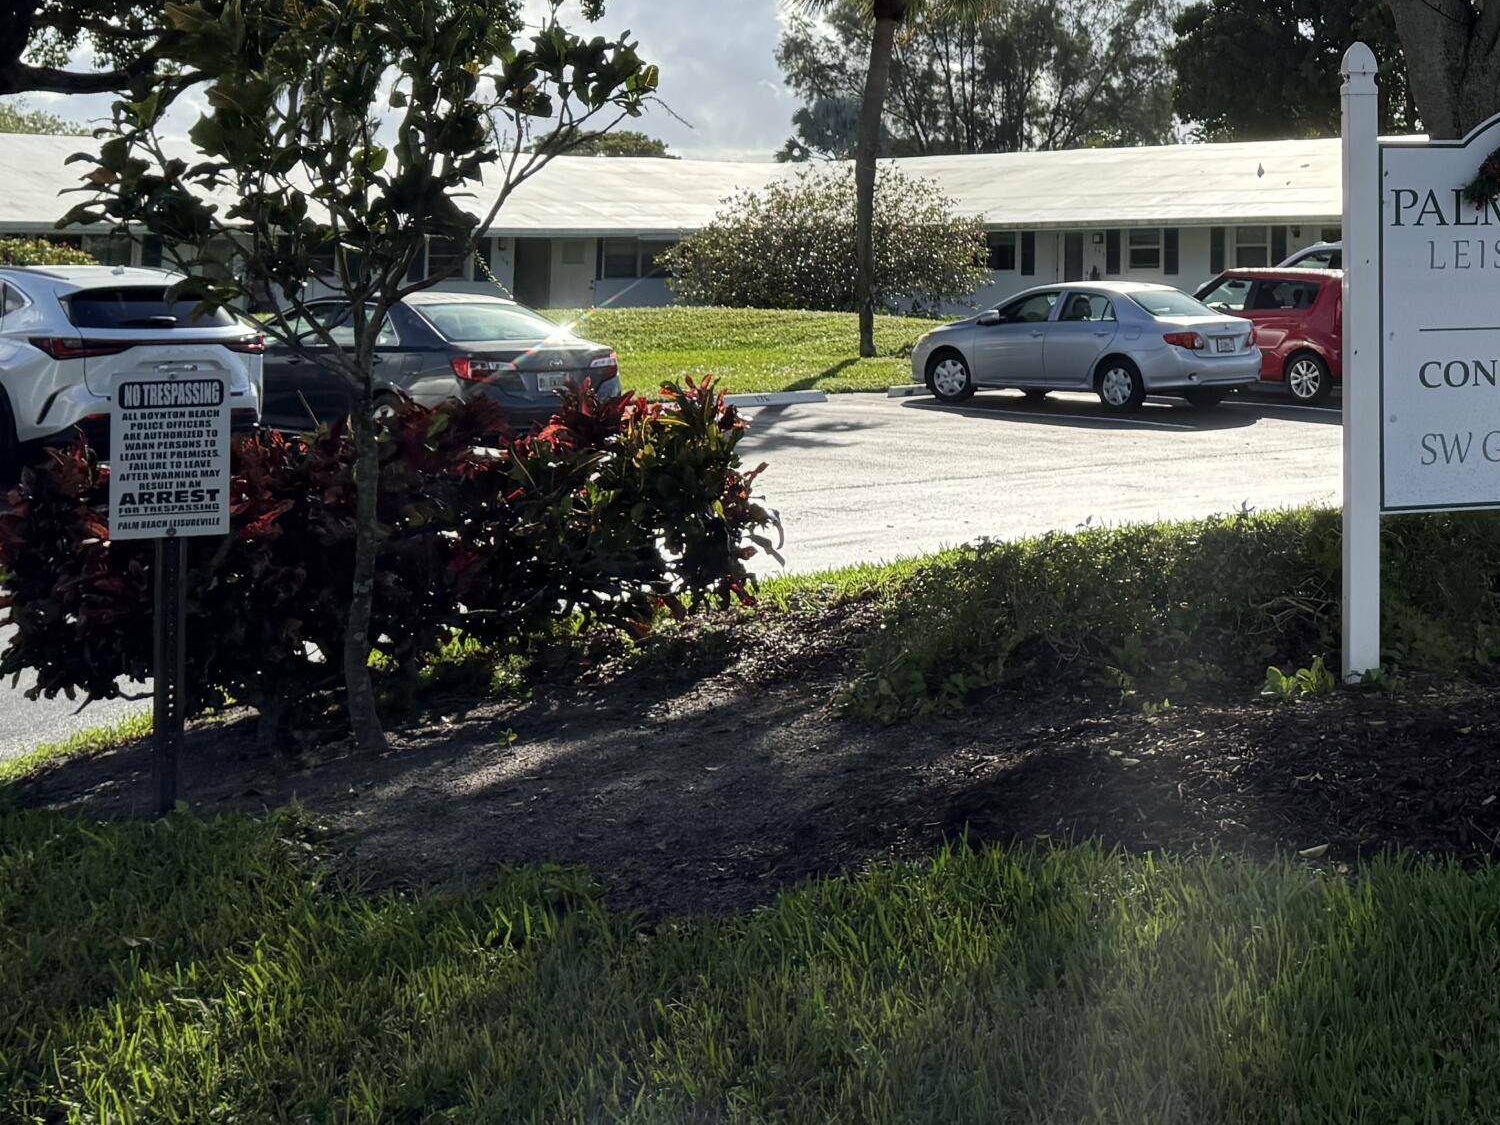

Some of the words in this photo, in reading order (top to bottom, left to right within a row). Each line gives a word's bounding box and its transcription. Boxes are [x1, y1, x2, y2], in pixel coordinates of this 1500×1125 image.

[124, 384, 140, 407] NO
[142, 381, 220, 406] TRESPASSING
[122, 412, 138, 421] ALL
[140, 411, 186, 420] BOYNTON
[188, 410, 220, 418] BEACH
[130, 421, 163, 430] POLICE
[166, 420, 212, 429] OFFICERS
[123, 432, 141, 441] ARE
[143, 430, 203, 440] AUTHORIZED
[206, 429, 218, 437] TO
[125, 442, 155, 451] WARN
[157, 440, 201, 449] PERSONS
[204, 439, 216, 448] TO
[1420, 431, 1473, 465] SW
[120, 452, 147, 461] LEAVE
[151, 451, 167, 460] THE
[129, 462, 167, 471] FAILURE
[170, 461, 181, 469] TO
[184, 459, 211, 468] LEAVE
[119, 472, 149, 481] AFTER
[151, 470, 198, 480] WARNING
[200, 469, 220, 478] MAY
[139, 481, 173, 491] RESULT
[176, 480, 186, 489] IN
[188, 479, 201, 488] AN
[119, 488, 220, 506] ARREST
[118, 506, 139, 514] FOR
[143, 503, 220, 513] TRESPASSING
[118, 521, 139, 530] PALM
[141, 519, 168, 529] BEACH
[169, 517, 220, 528] LEISUREVILLE
